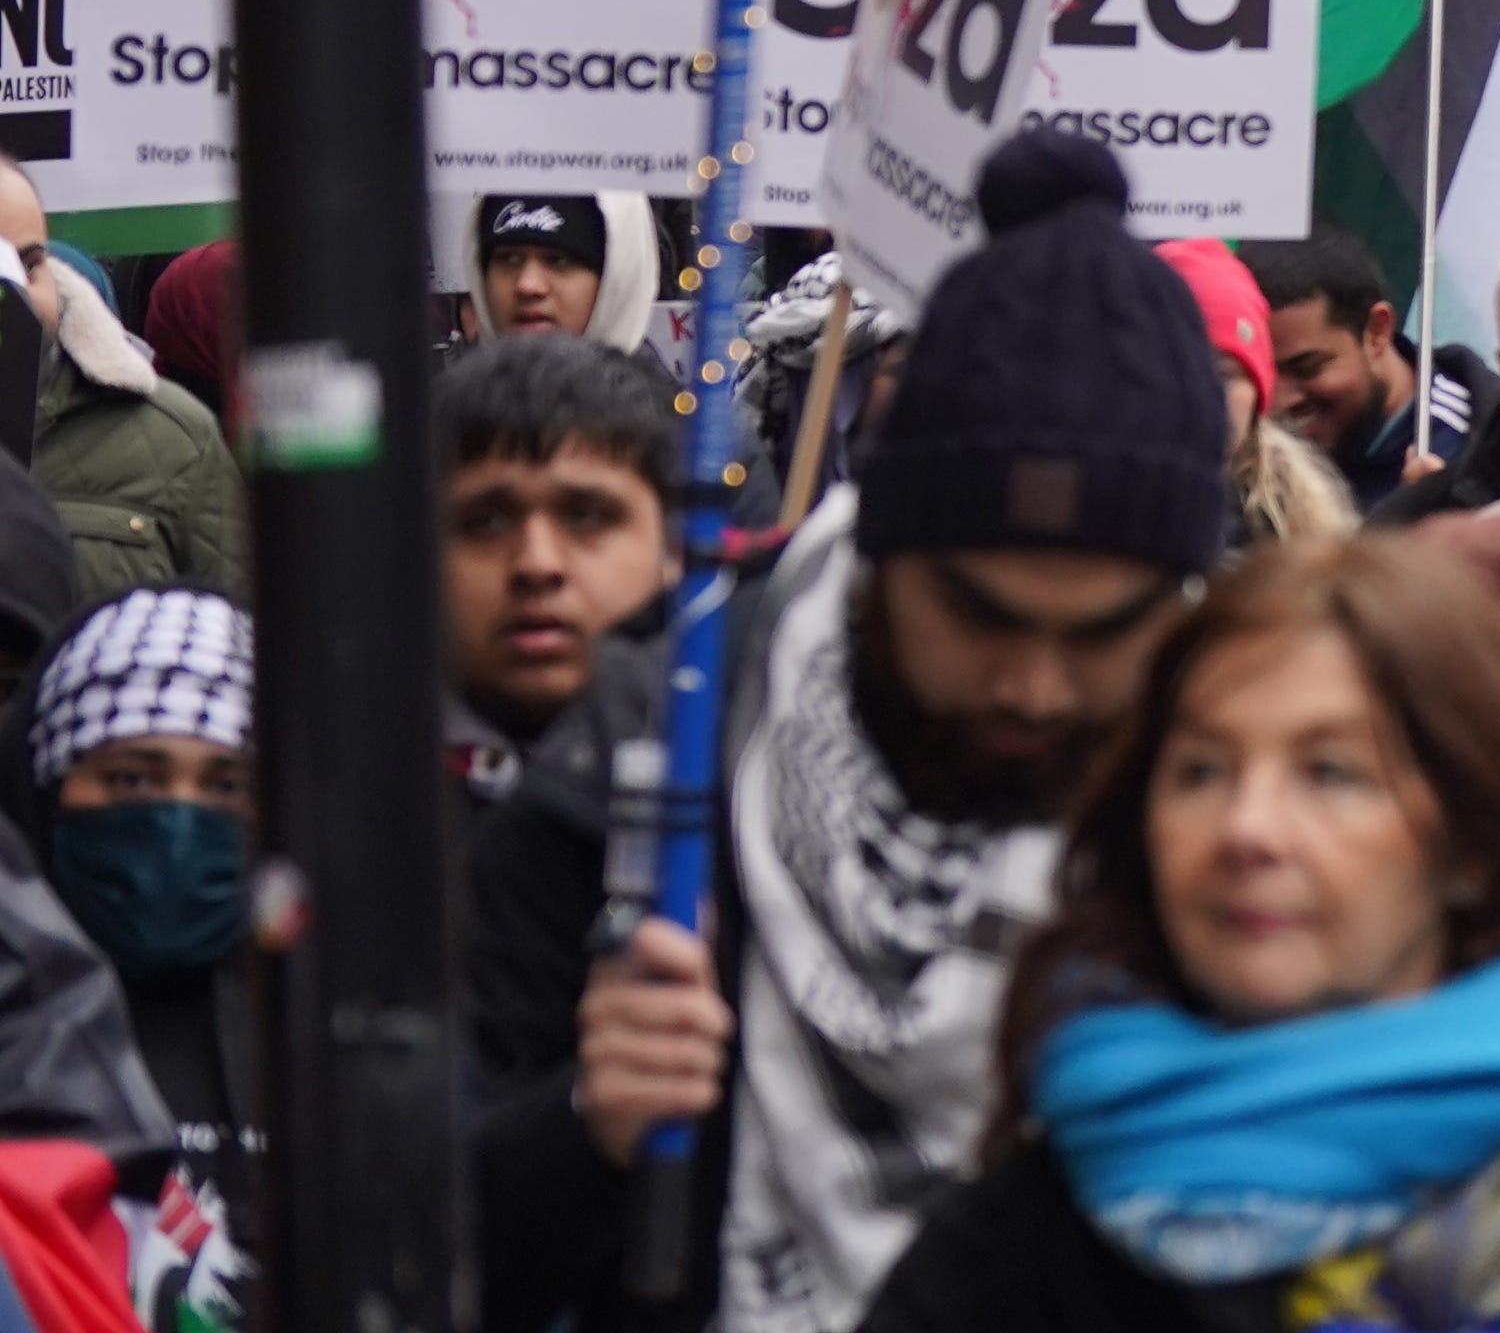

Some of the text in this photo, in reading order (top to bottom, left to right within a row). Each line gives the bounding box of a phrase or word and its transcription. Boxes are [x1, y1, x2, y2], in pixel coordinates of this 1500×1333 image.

[137, 144, 190, 166] Stop
[434, 149, 689, 175] www.stopwar.org.uk
[763, 185, 811, 206] Stop
